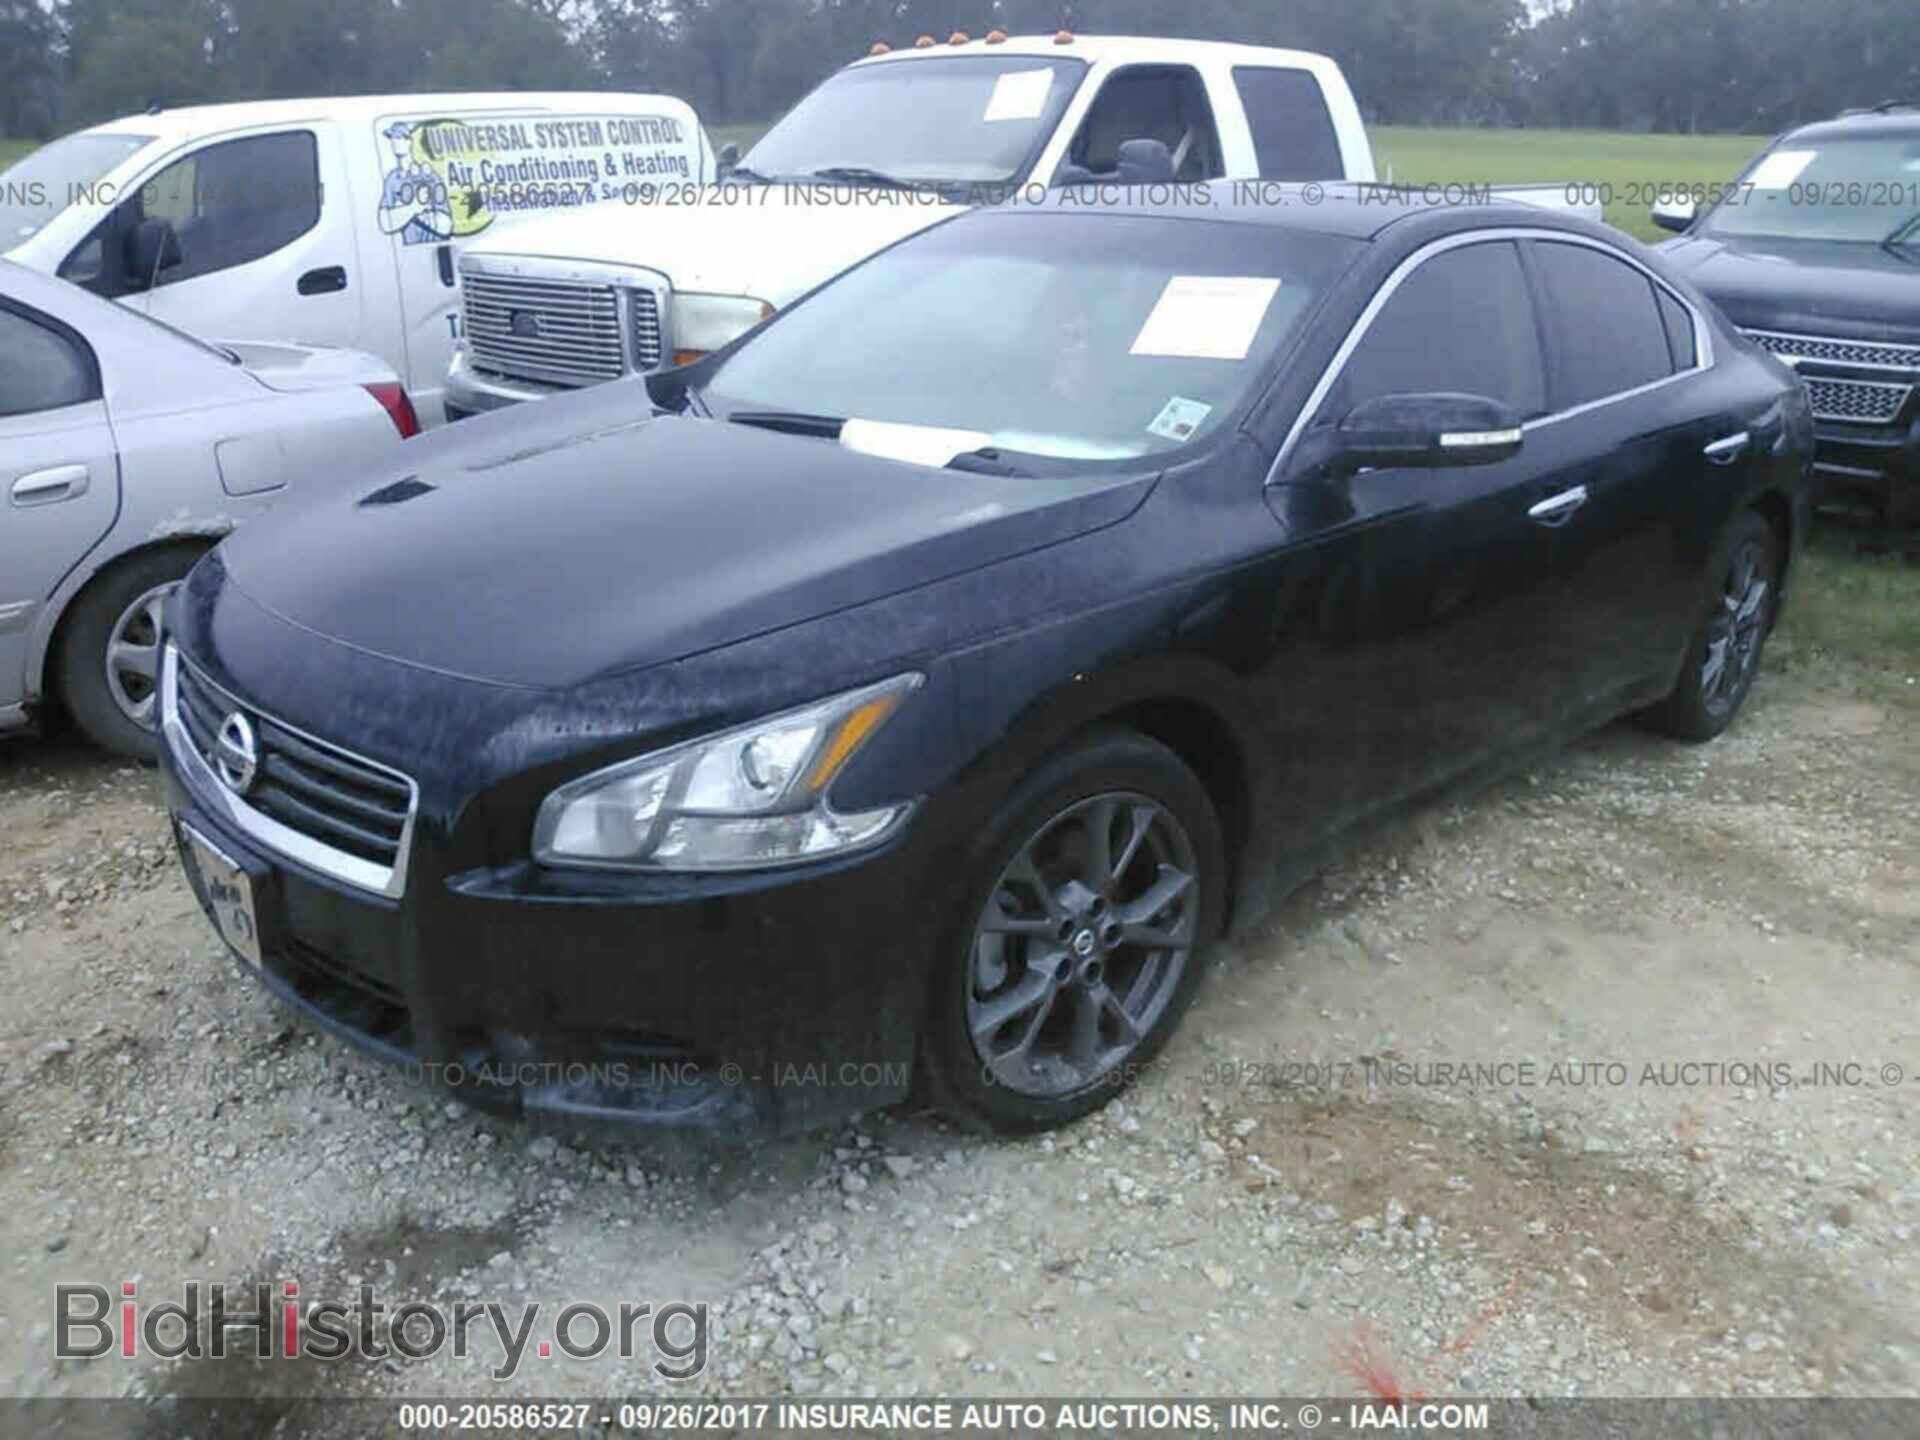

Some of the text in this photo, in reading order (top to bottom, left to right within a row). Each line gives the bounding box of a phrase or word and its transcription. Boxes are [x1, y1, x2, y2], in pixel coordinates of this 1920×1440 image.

[428, 118, 683, 155] UNIVERSAL SYSTEM CONTROL
[448, 150, 690, 186] Air Conditioning & Heating
